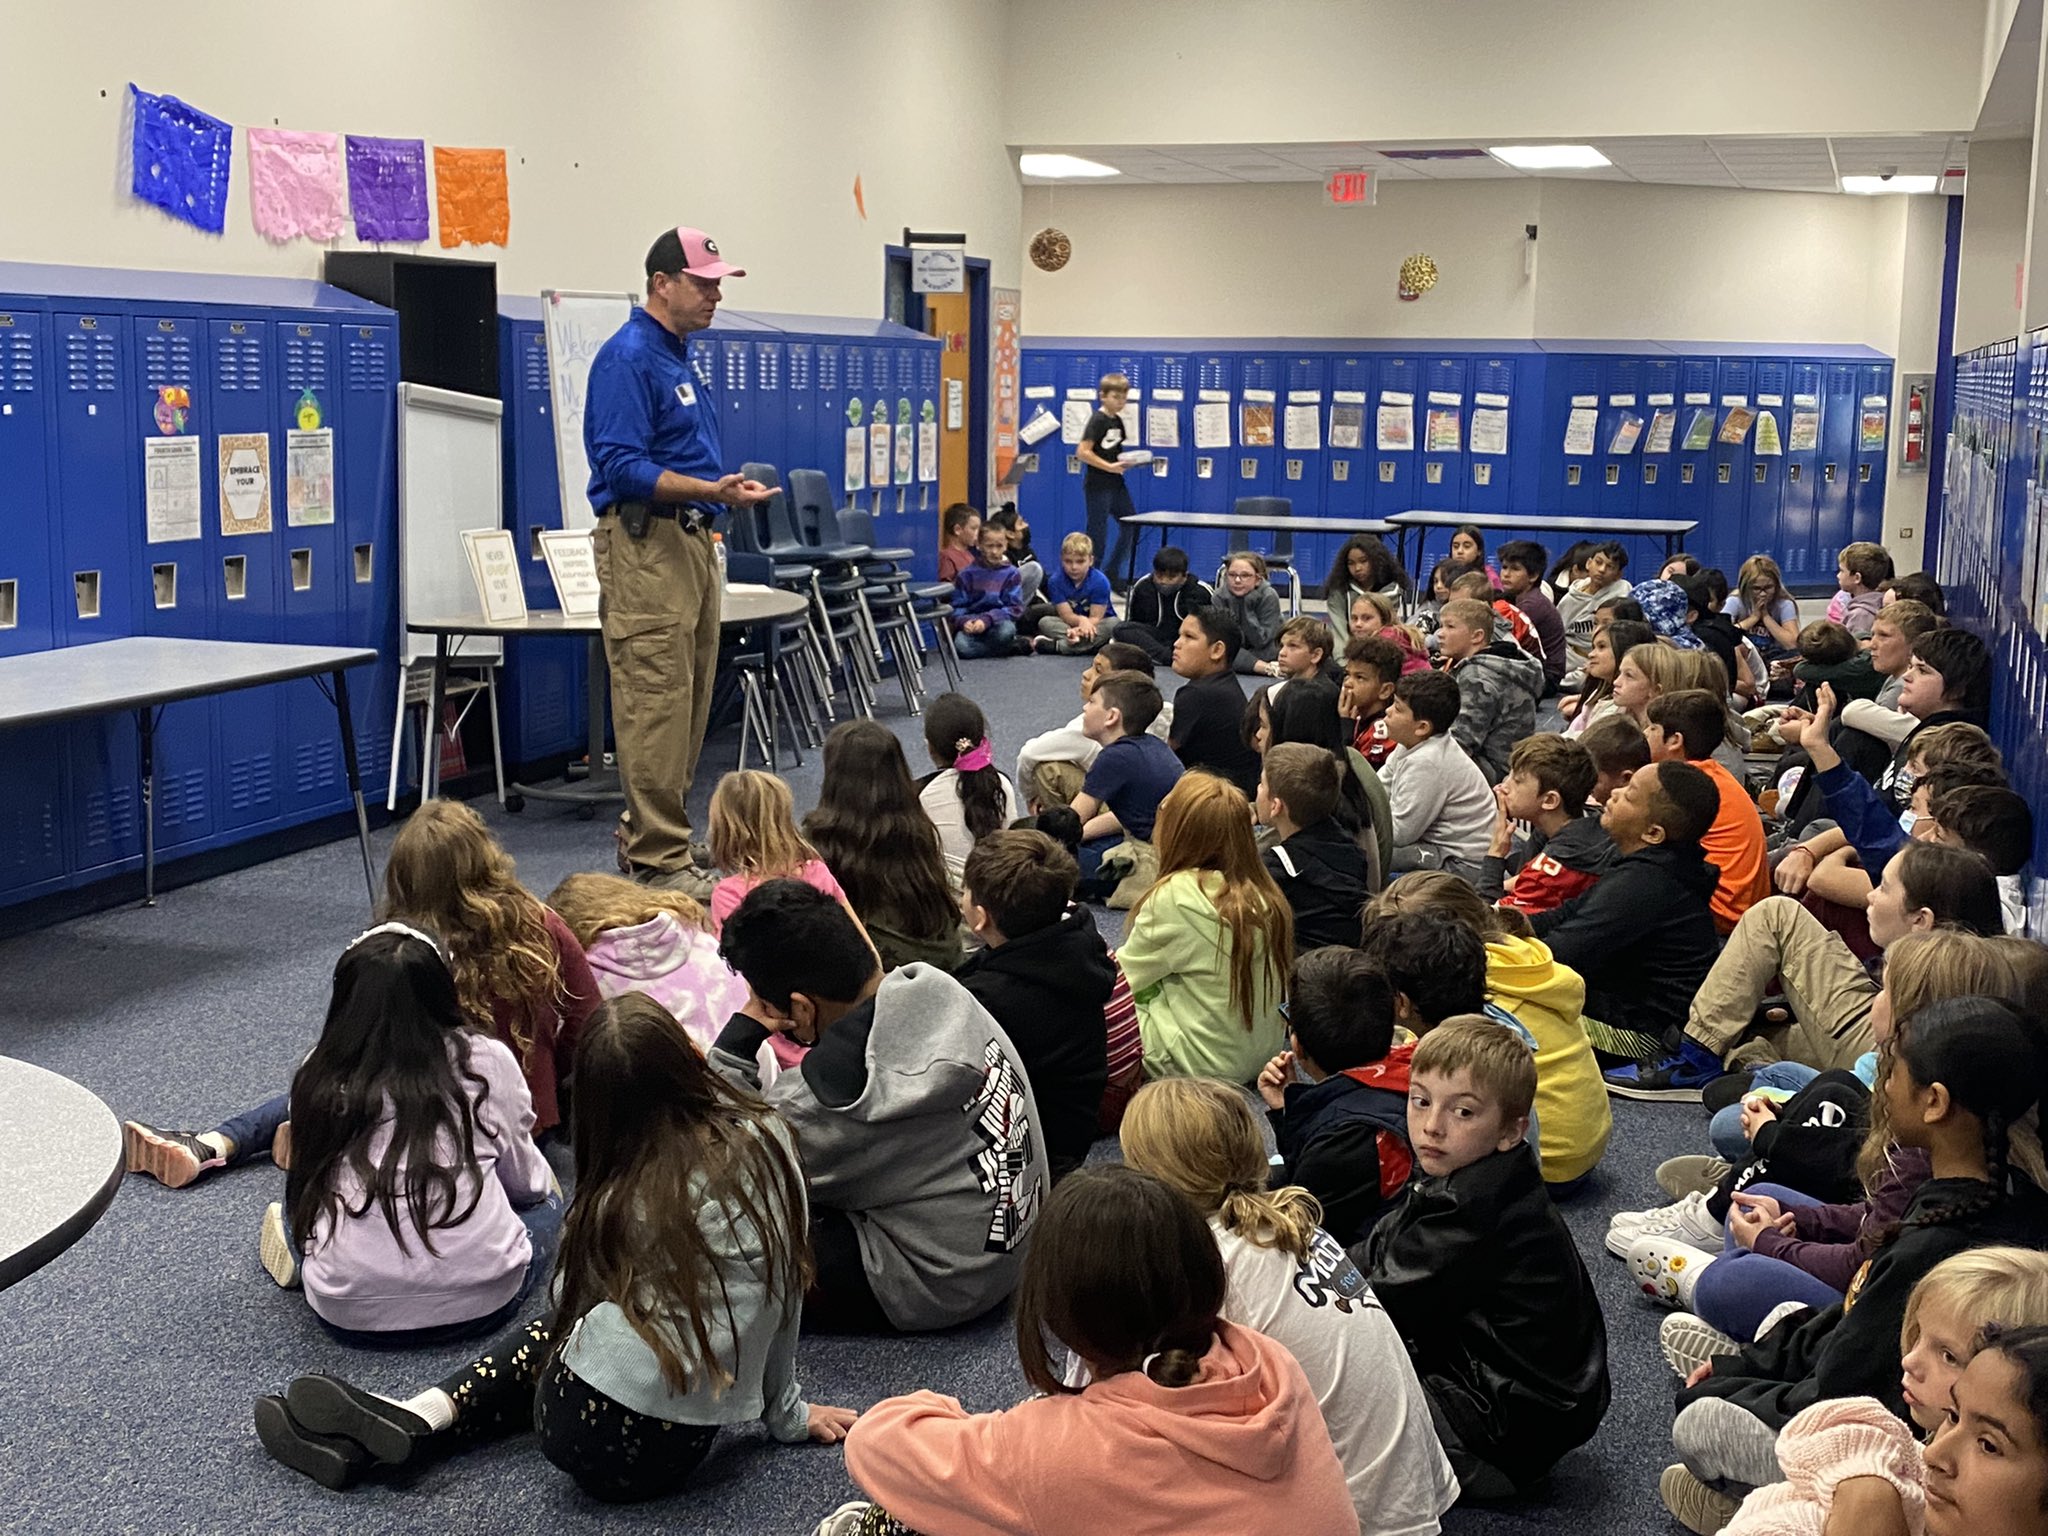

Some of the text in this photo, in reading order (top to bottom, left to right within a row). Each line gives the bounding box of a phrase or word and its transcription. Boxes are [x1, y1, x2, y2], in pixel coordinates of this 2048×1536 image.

[230, 466, 260, 475] EMBRACE
[236, 478, 254, 486] YOUR
[1531, 852, 1563, 877] 15
